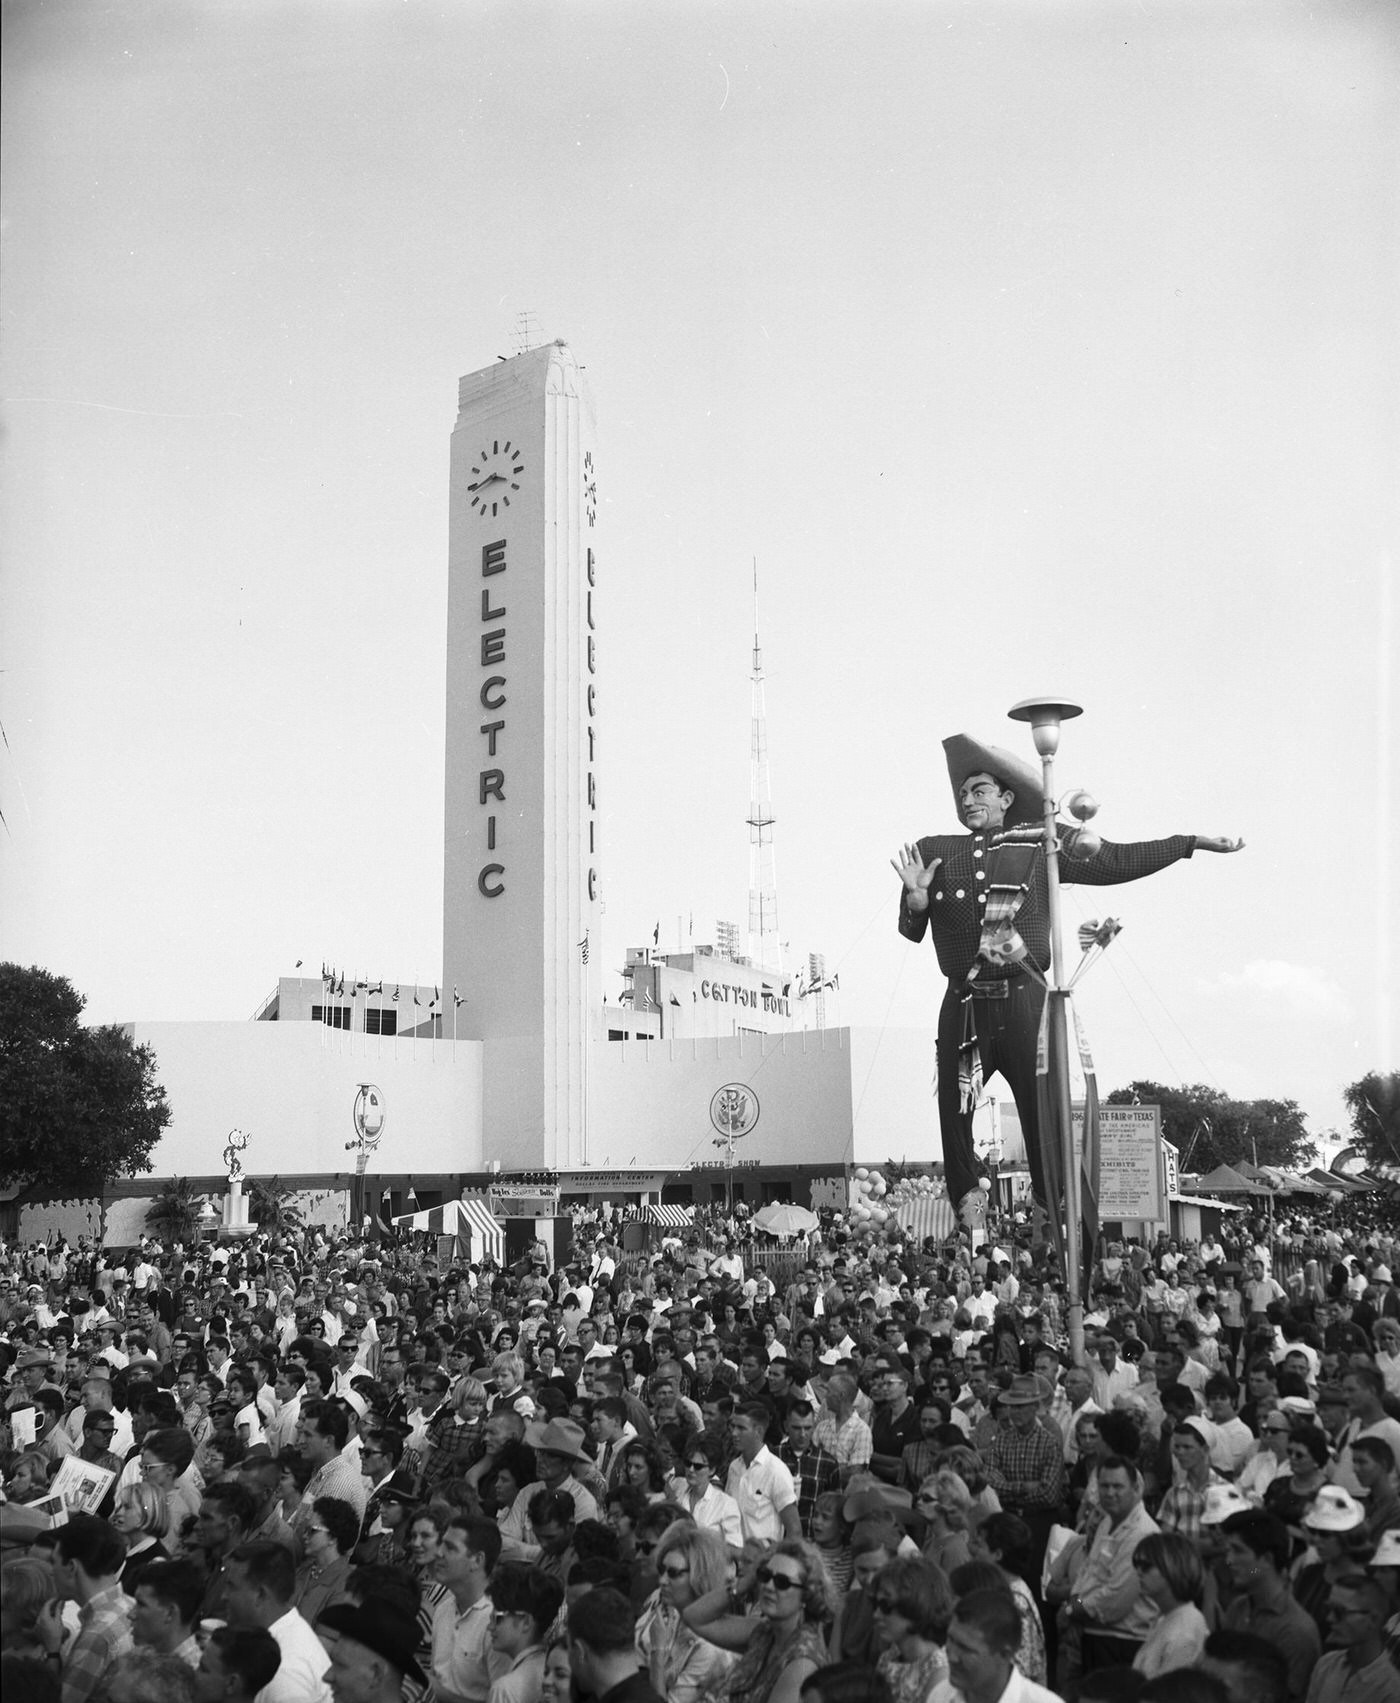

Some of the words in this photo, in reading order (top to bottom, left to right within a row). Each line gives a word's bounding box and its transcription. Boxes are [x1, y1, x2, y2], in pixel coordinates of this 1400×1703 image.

[478, 539, 507, 898] ELECTRIC
[701, 979, 757, 1008] COTTON
[1111, 1112, 1126, 1121] FAIR
[1133, 1112, 1154, 1121] TEXAS
[1168, 1150, 1176, 1193] HATS
